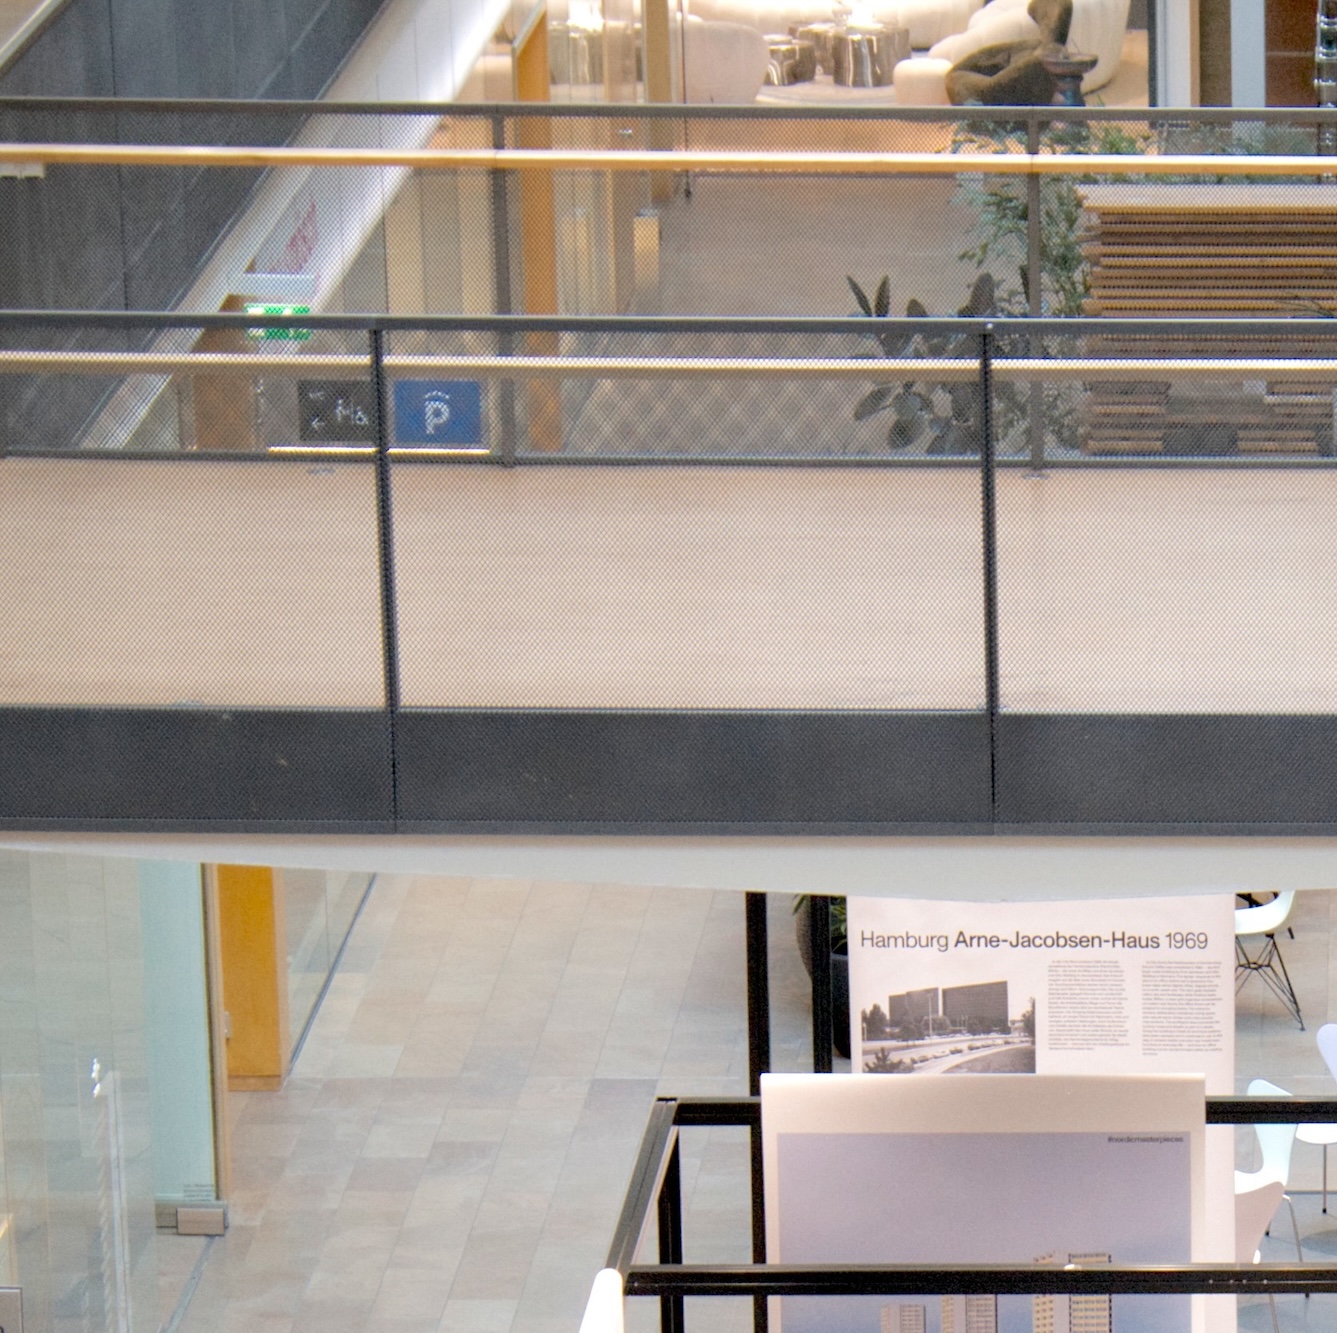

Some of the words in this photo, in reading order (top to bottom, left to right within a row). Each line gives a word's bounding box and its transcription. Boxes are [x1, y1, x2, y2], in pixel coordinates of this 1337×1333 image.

[425, 401, 450, 434] P
[861, 930, 948, 952] Hamburg
[954, 931, 1160, 948] Arne-Jacobsen-Haus
[1166, 932, 1208, 949] 1969
[1107, 1135, 1184, 1144] #nordicmasterpieces
